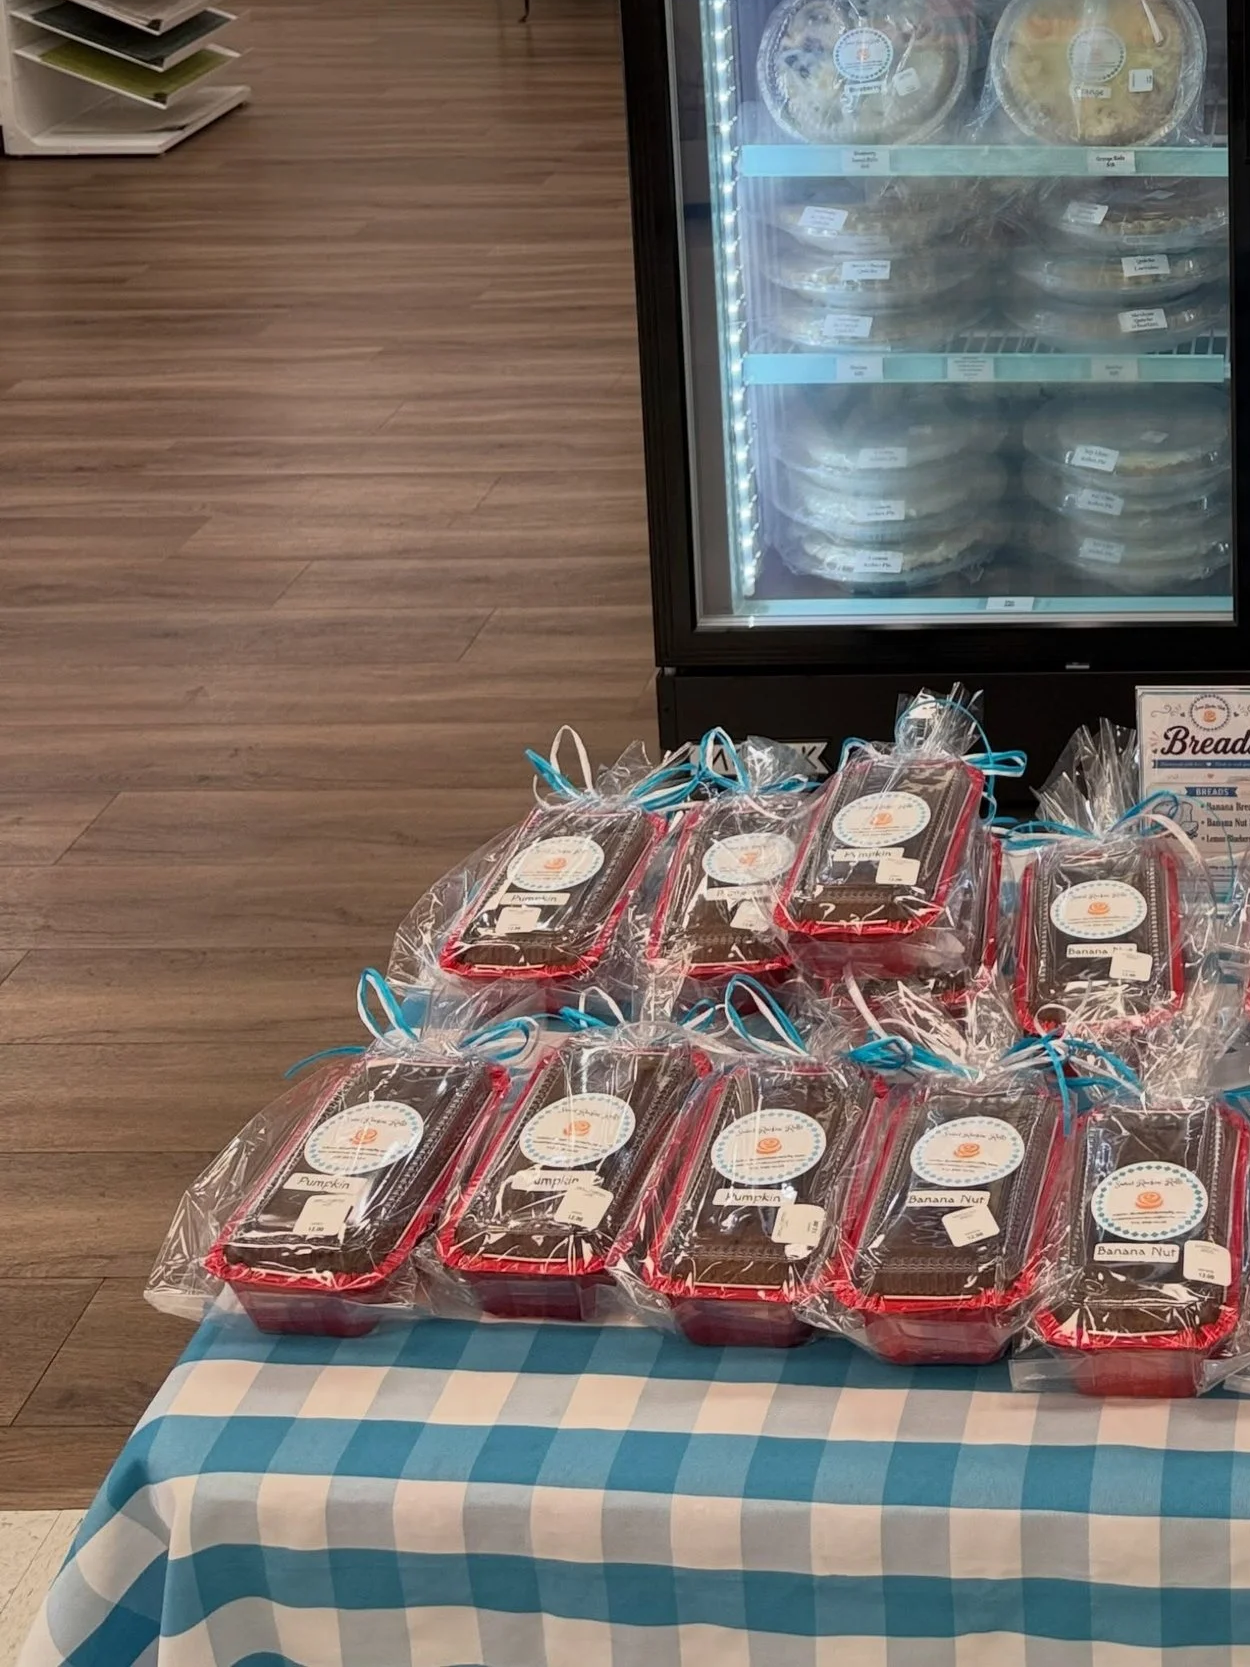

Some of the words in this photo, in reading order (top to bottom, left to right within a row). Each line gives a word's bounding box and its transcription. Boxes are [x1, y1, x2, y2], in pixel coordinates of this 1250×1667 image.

[1195, 788, 1230, 796] BREADS
[1206, 802, 1234, 811] Banana
[1206, 818, 1233, 827] Banana
[1234, 818, 1247, 827] Nut
[1068, 946, 1108, 956] Banana
[298, 1178, 350, 1191] Pumpkin
[725, 1192, 781, 1203] Pumpkin
[908, 1194, 955, 1205] Banana
[960, 1194, 986, 1206] Nut
[1097, 1245, 1146, 1257] Banana
[1152, 1246, 1177, 1258] Nut
